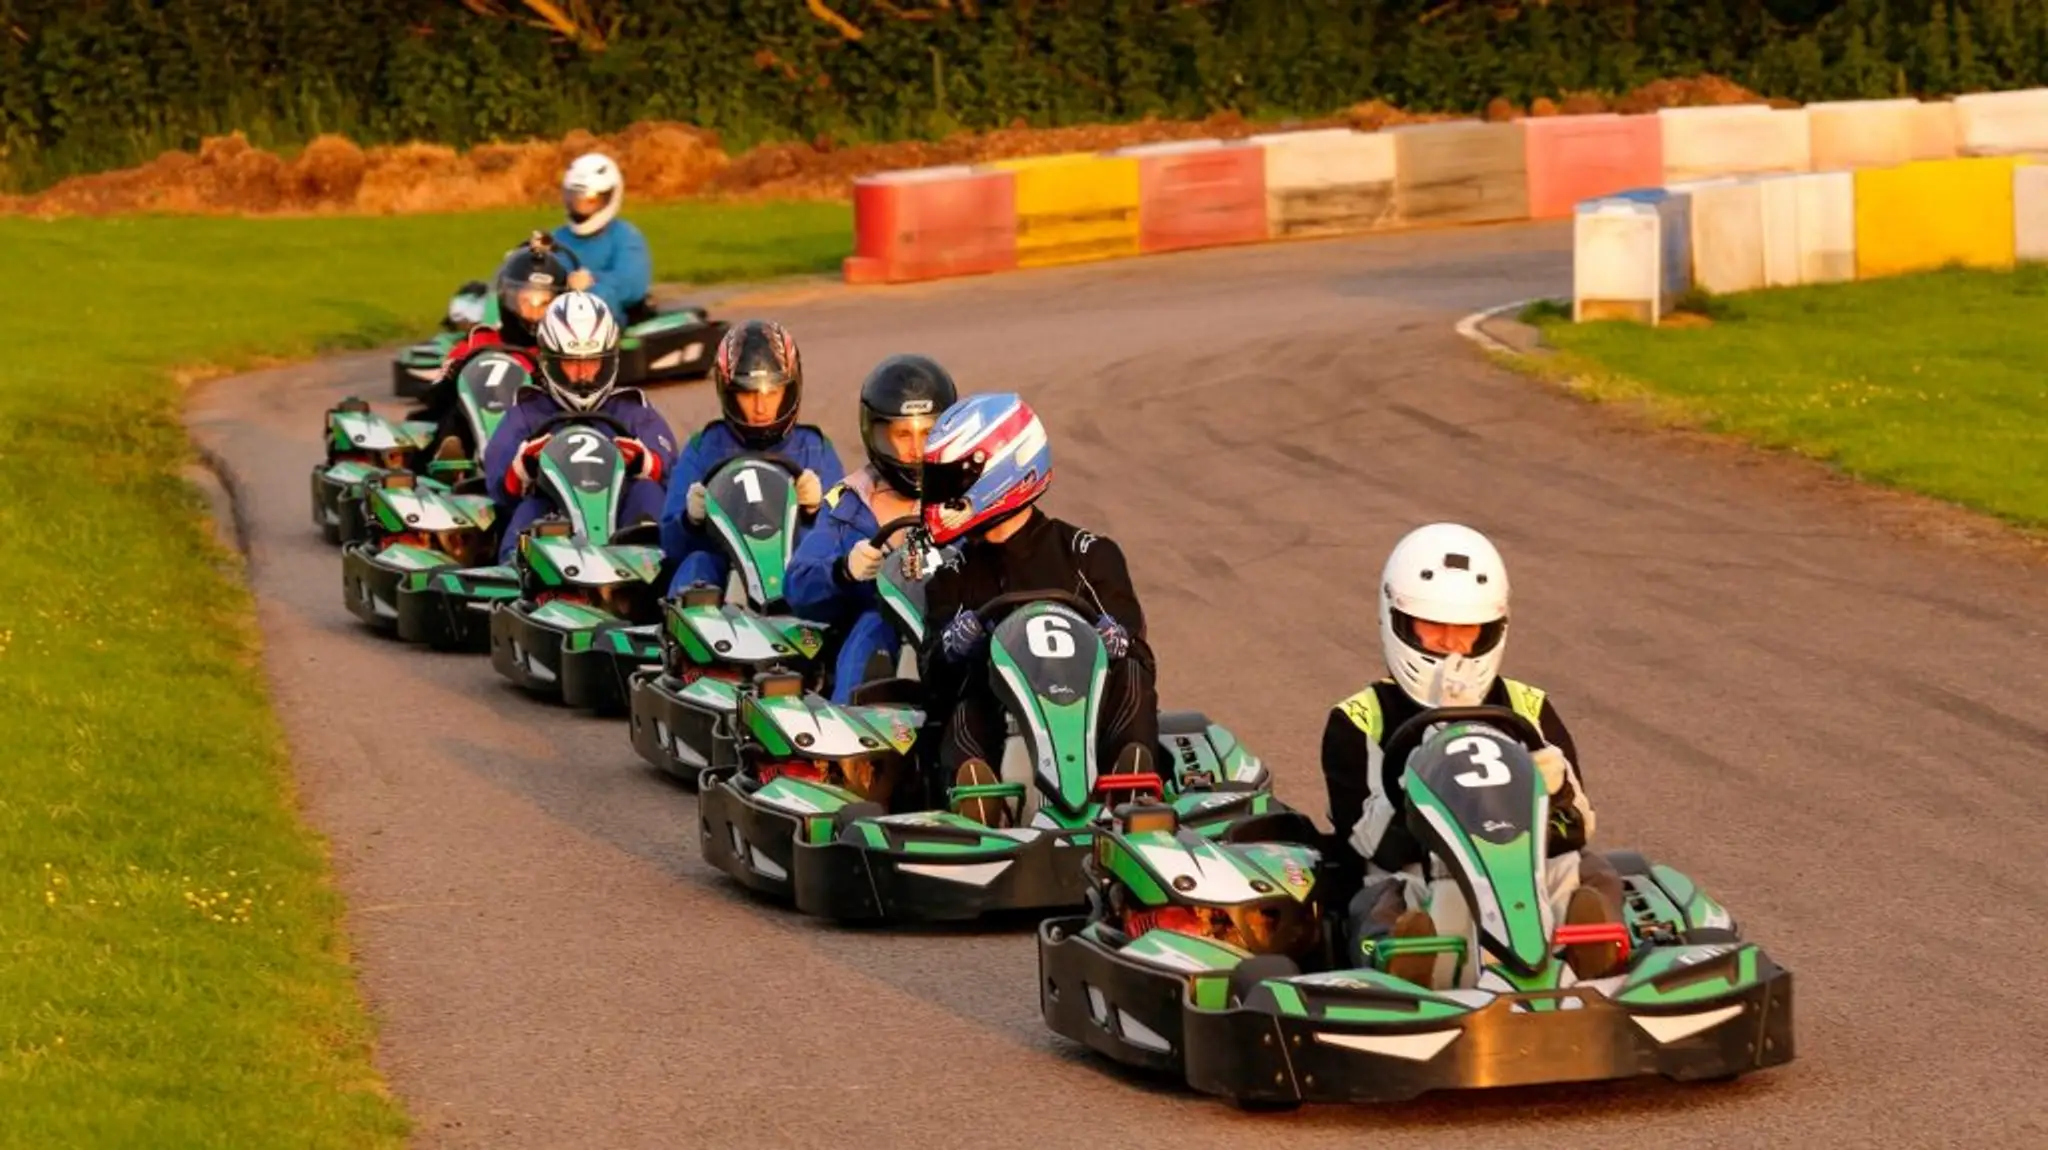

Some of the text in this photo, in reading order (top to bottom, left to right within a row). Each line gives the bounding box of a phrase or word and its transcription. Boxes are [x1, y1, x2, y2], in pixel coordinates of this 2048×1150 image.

[478, 360, 510, 387] 7
[567, 433, 605, 465] 2
[733, 468, 763, 503] 1
[1026, 615, 1075, 658] 6
[1445, 736, 1511, 787] 3
